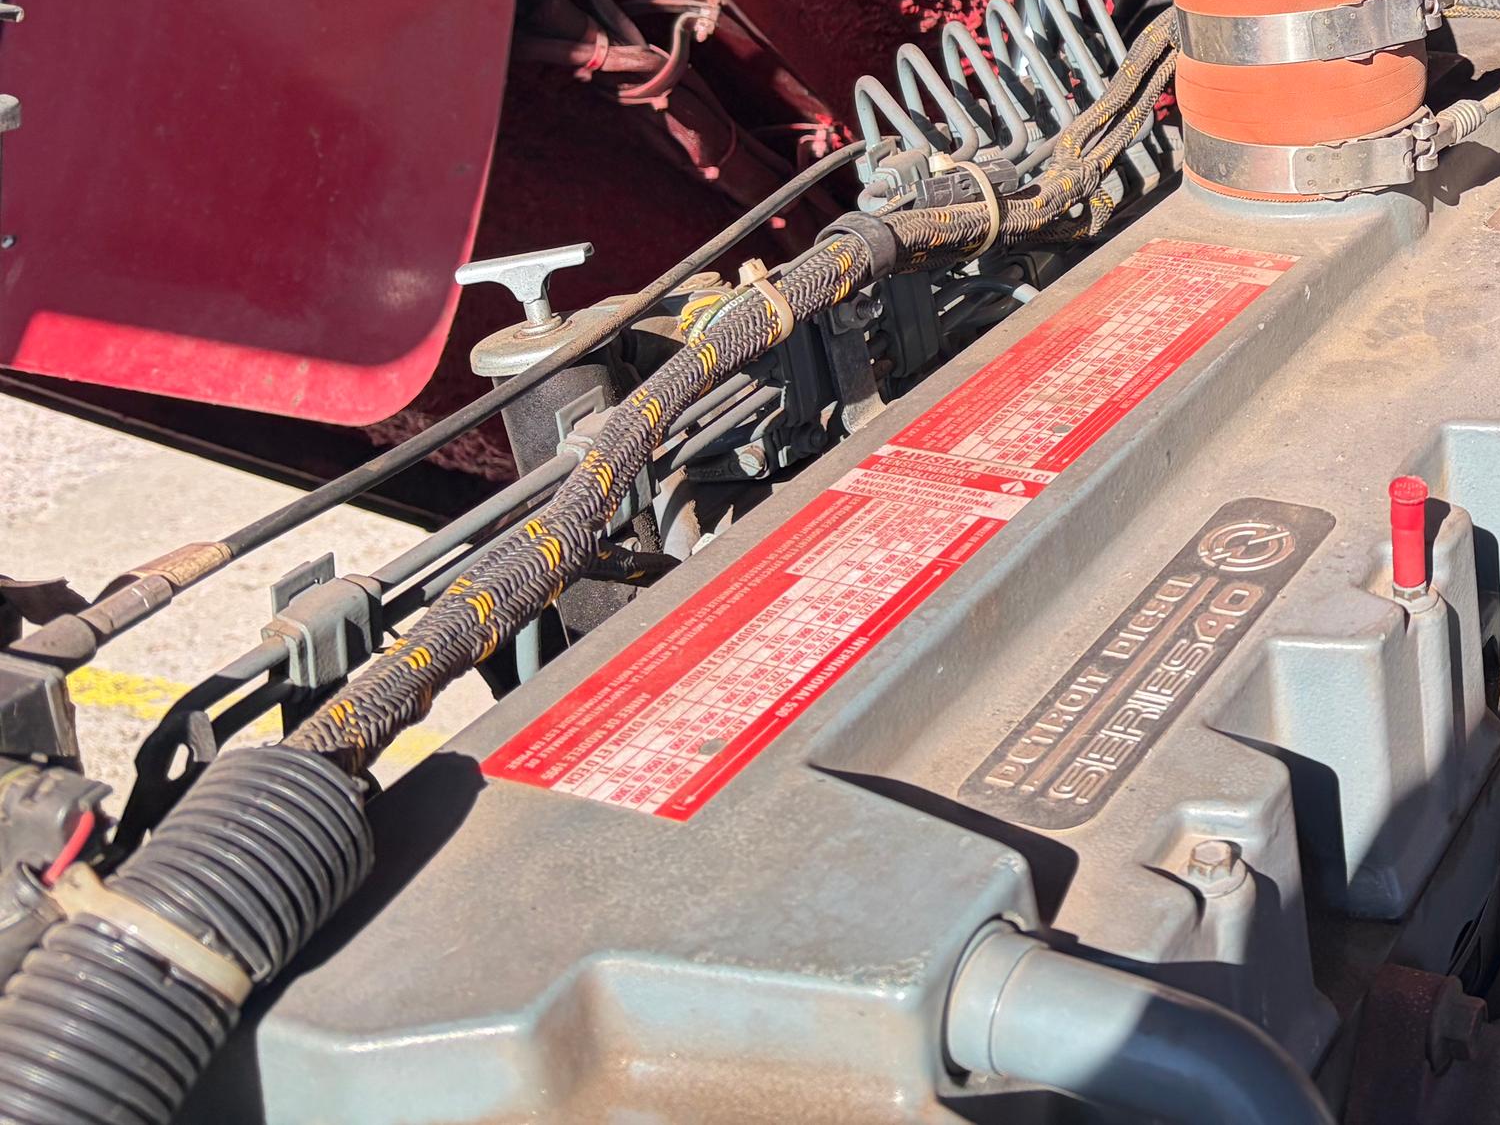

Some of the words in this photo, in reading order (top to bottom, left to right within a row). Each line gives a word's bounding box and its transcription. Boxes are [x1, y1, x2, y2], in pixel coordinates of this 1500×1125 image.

[718, 295, 745, 318] COMP
[874, 457, 984, 479] RENSEIGNEMENTS
[884, 449, 978, 470] NAVISTAR
[859, 471, 908, 483] MOTEUR
[841, 484, 945, 506] TRANSPORTATION
[850, 478, 909, 492] NAVISTAR
[904, 487, 998, 508] INTERNATIONAL
[768, 595, 796, 610] JEU
[752, 608, 780, 623] DES
[709, 622, 764, 660] SOUPAPES
[789, 636, 871, 702] INTERNATIONAL
[982, 664, 1117, 789] DETROIT
[1097, 570, 1203, 660] DIESEL
[599, 717, 623, 730] DE
[591, 748, 615, 759] ET
